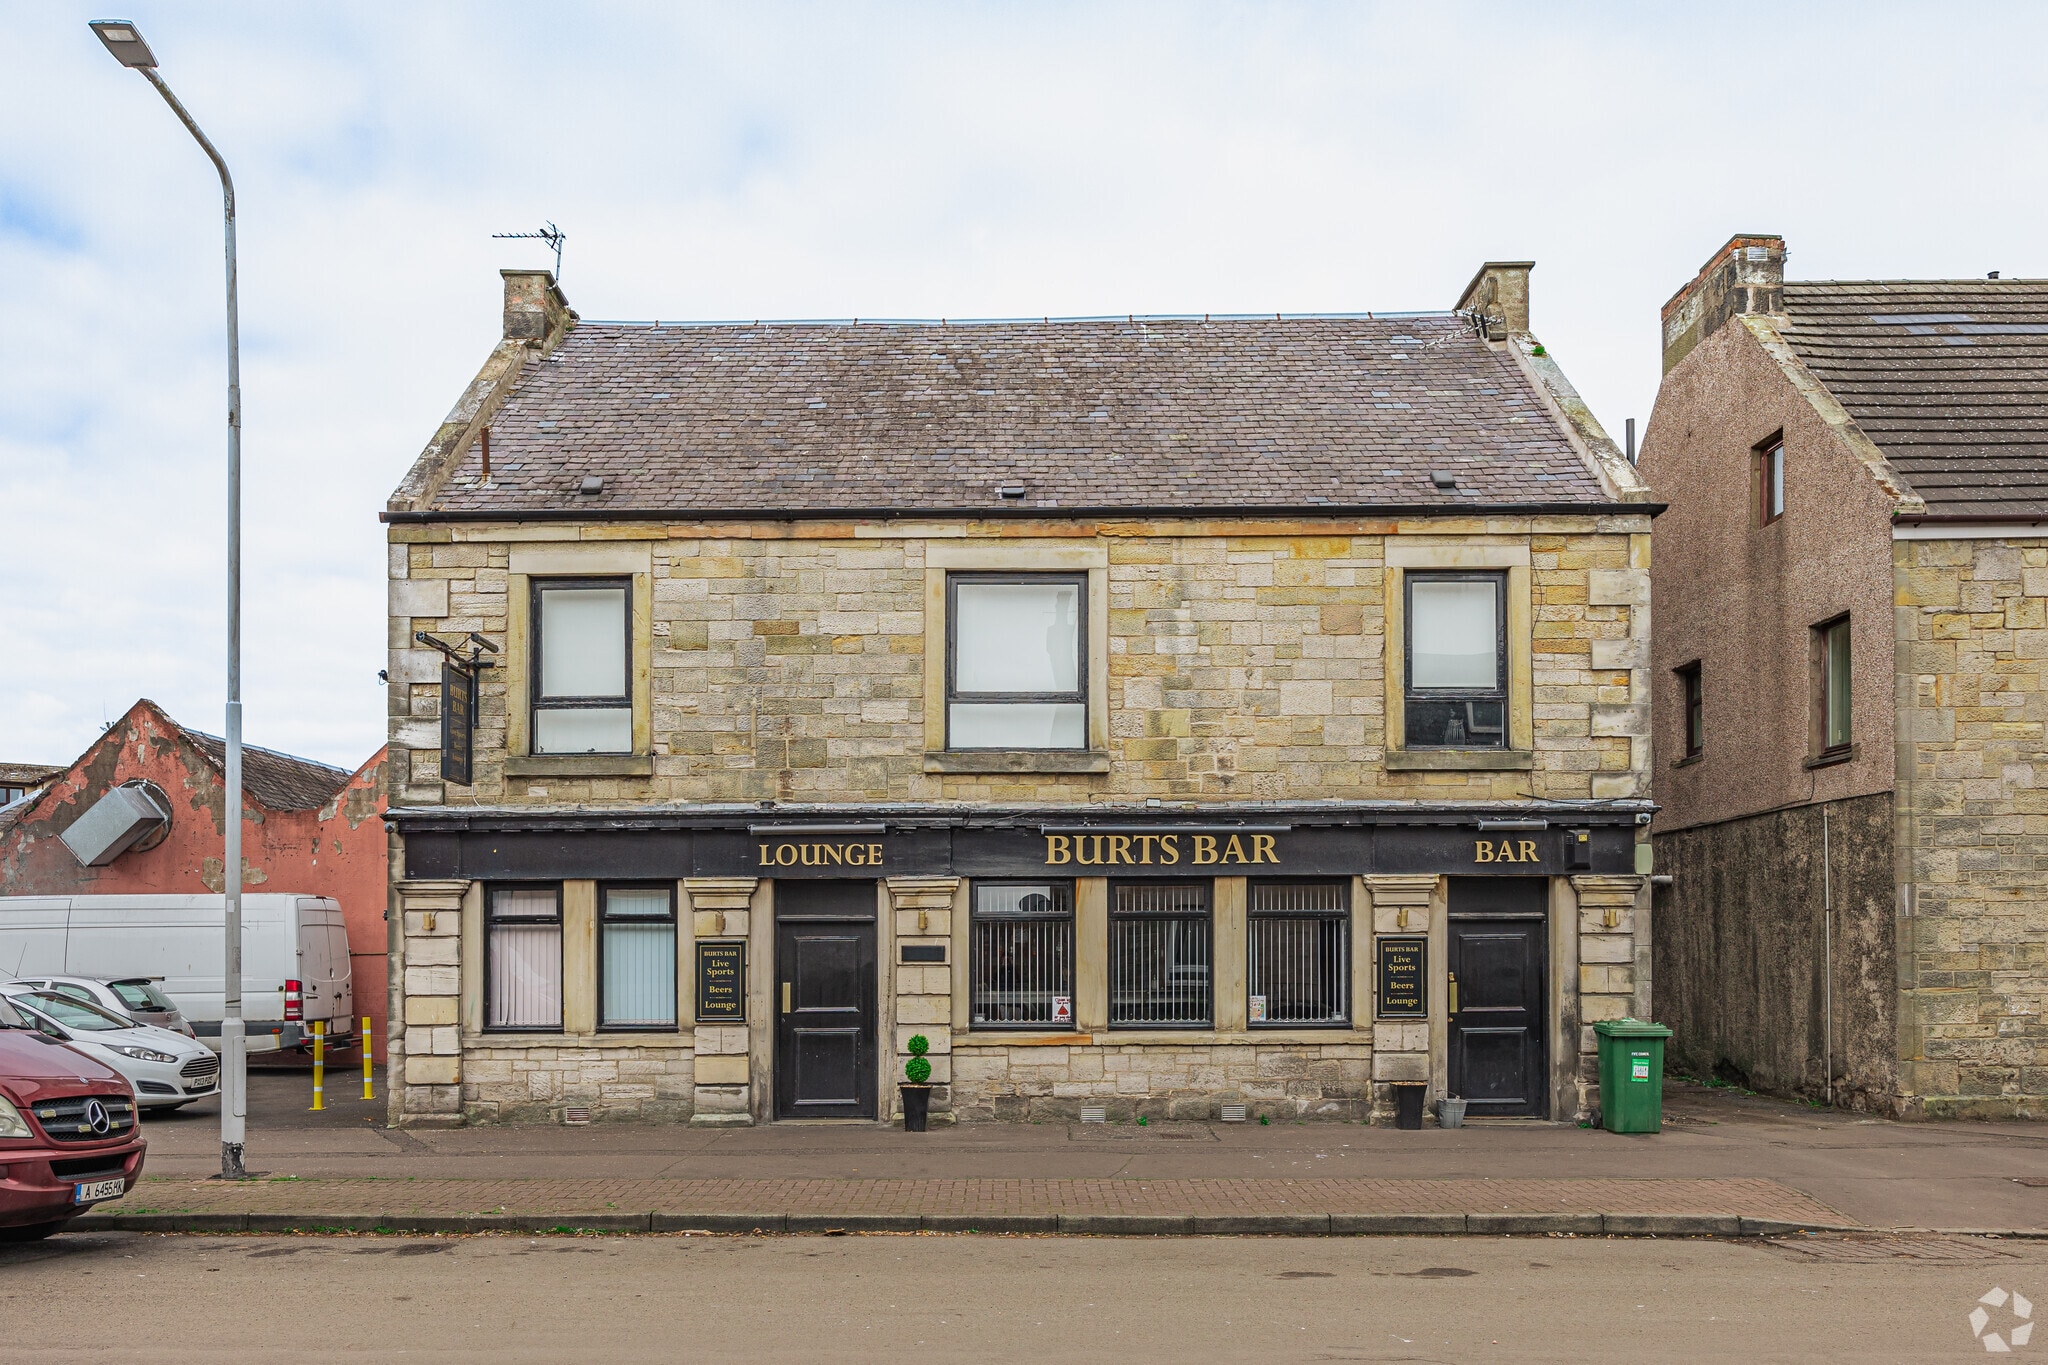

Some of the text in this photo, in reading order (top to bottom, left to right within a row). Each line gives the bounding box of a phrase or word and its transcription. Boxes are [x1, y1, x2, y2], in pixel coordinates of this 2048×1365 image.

[758, 843, 884, 866] LOUNGE
[1045, 834, 1281, 865] BURTS BAR
[1474, 840, 1541, 863] BAR
[1393, 955, 1411, 963] Live
[707, 968, 734, 978] Sports
[1388, 963, 1416, 974] Sports
[705, 1001, 736, 1011] Lounge
[1386, 997, 1418, 1007] Lounge
[85, 1185, 91, 1199] A
